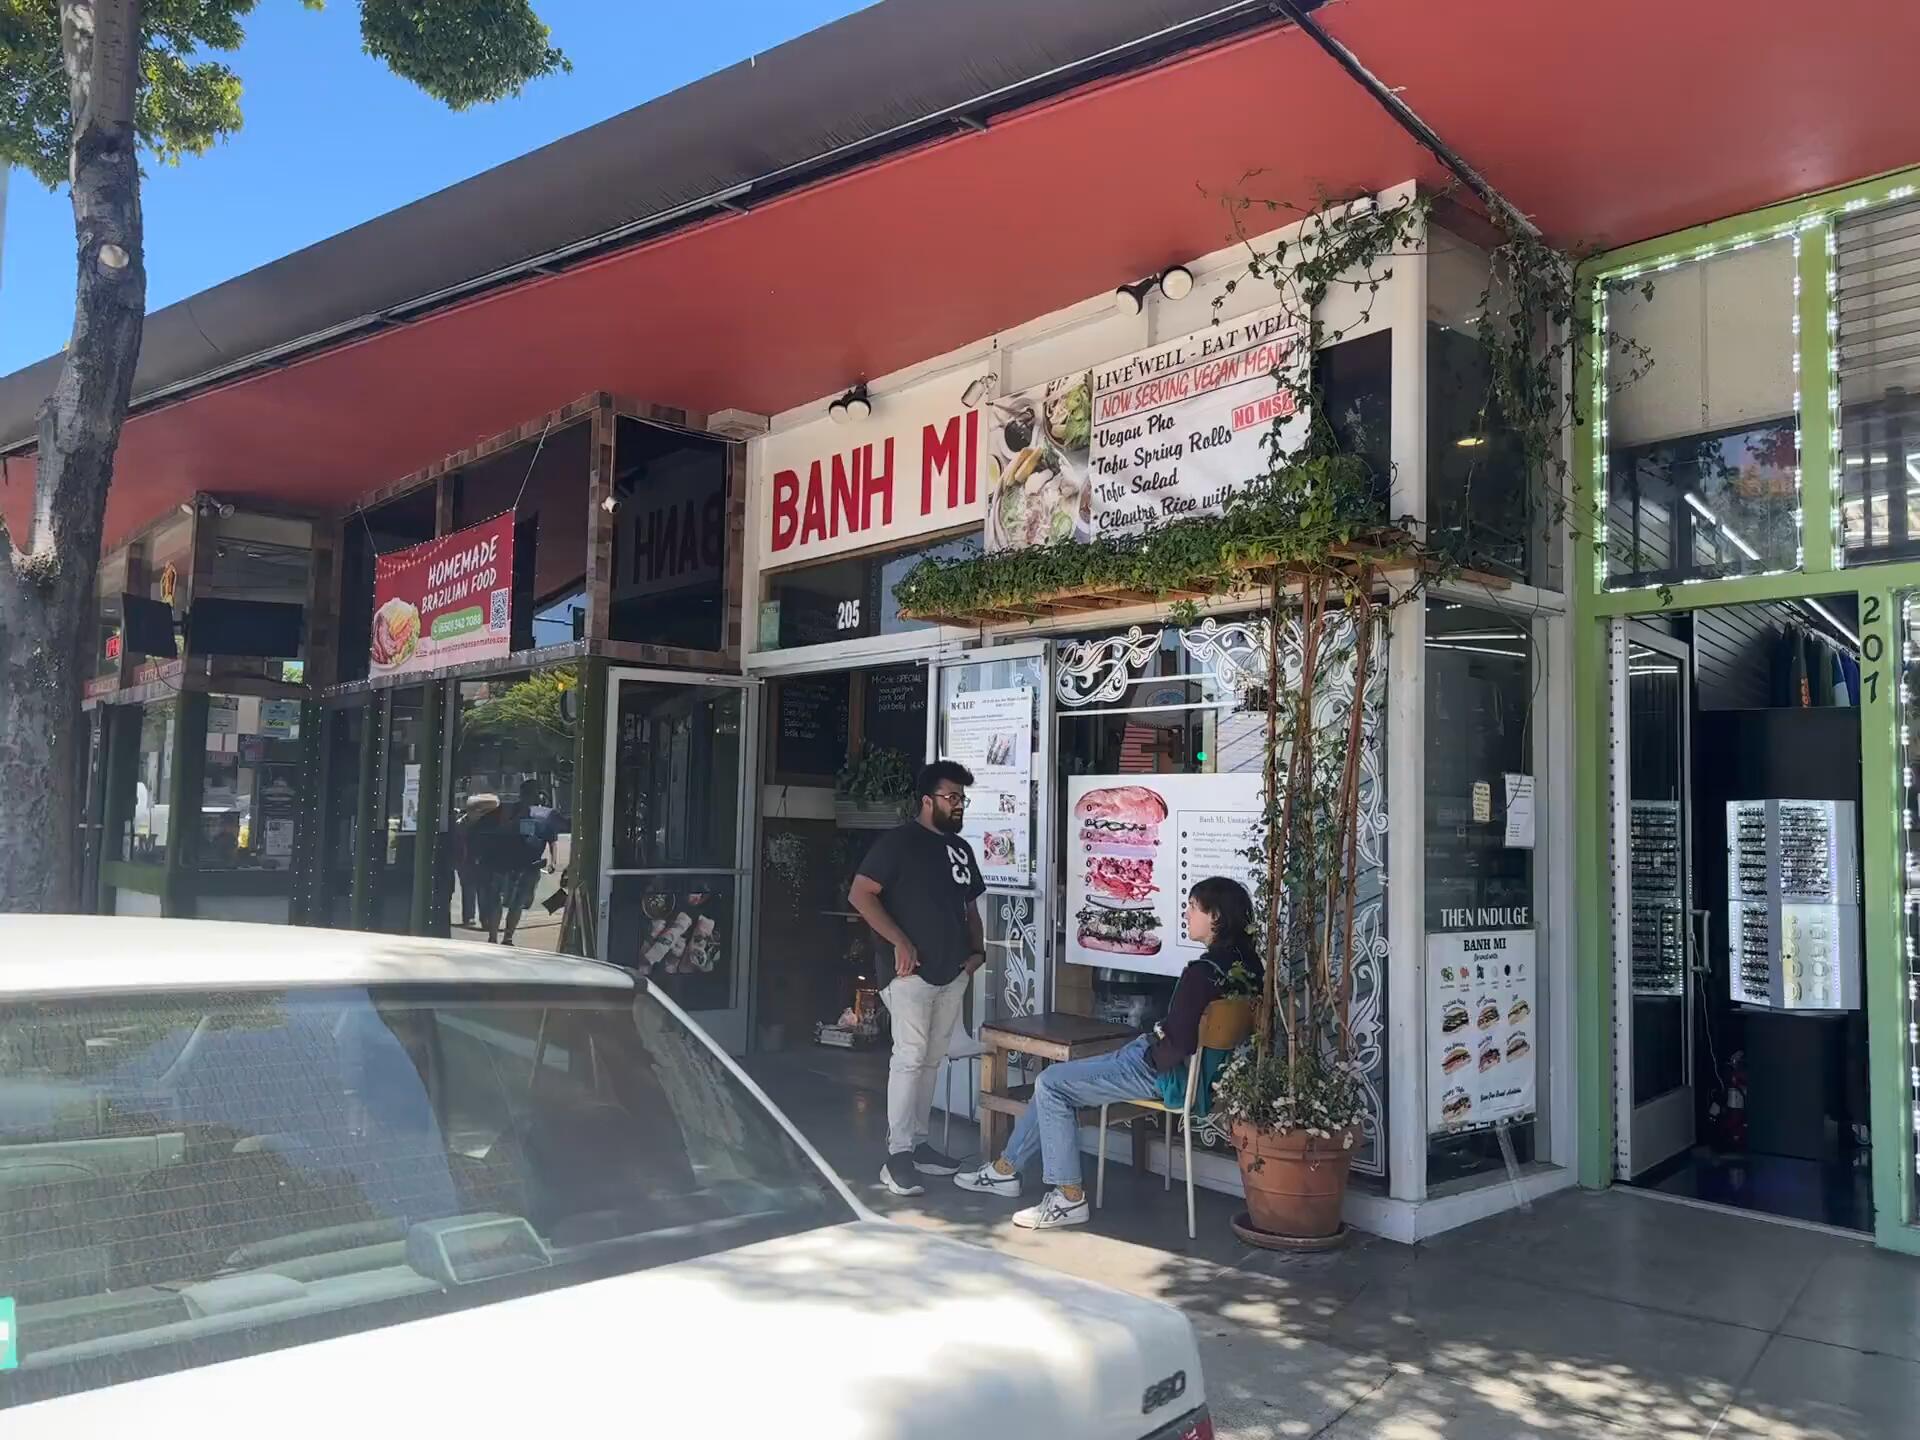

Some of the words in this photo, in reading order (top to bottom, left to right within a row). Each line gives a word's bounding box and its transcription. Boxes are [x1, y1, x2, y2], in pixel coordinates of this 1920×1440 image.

[1097, 366, 1134, 391] LIVE
[1138, 348, 1186, 377] WELL
[1202, 329, 1239, 357] EAT
[1244, 313, 1299, 342] WELL
[1100, 391, 1134, 420] NOW
[1134, 371, 1189, 410] SERVING
[1193, 355, 1243, 391] VEGAN
[1243, 340, 1294, 375] MENU
[1234, 406, 1255, 428] NO
[1258, 392, 1294, 419] MSG
[1097, 456, 1130, 476] Tofu
[1133, 442, 1183, 465] Spring
[1189, 425, 1232, 453] Rolls
[1099, 423, 1143, 450] Vegan
[1147, 413, 1176, 436] Pho
[772, 437, 895, 552] BANH
[920, 409, 978, 516] MI
[1099, 483, 1127, 503] Tofu
[1131, 467, 1179, 495] Salad
[1099, 506, 1157, 530] Cilantro
[1160, 495, 1198, 516] Rice
[427, 534, 500, 590] HOMEMADE
[421, 580, 469, 614] BRAZILIAN
[471, 567, 497, 593] FOOD
[838, 599, 860, 629] 205
[1862, 596, 1883, 703] 207
[946, 845, 971, 885] 23
[1441, 908, 1474, 927] THEN
[1478, 907, 1528, 926] INDULGE
[1463, 939, 1491, 951] BANH
[1493, 938, 1507, 949] MI
